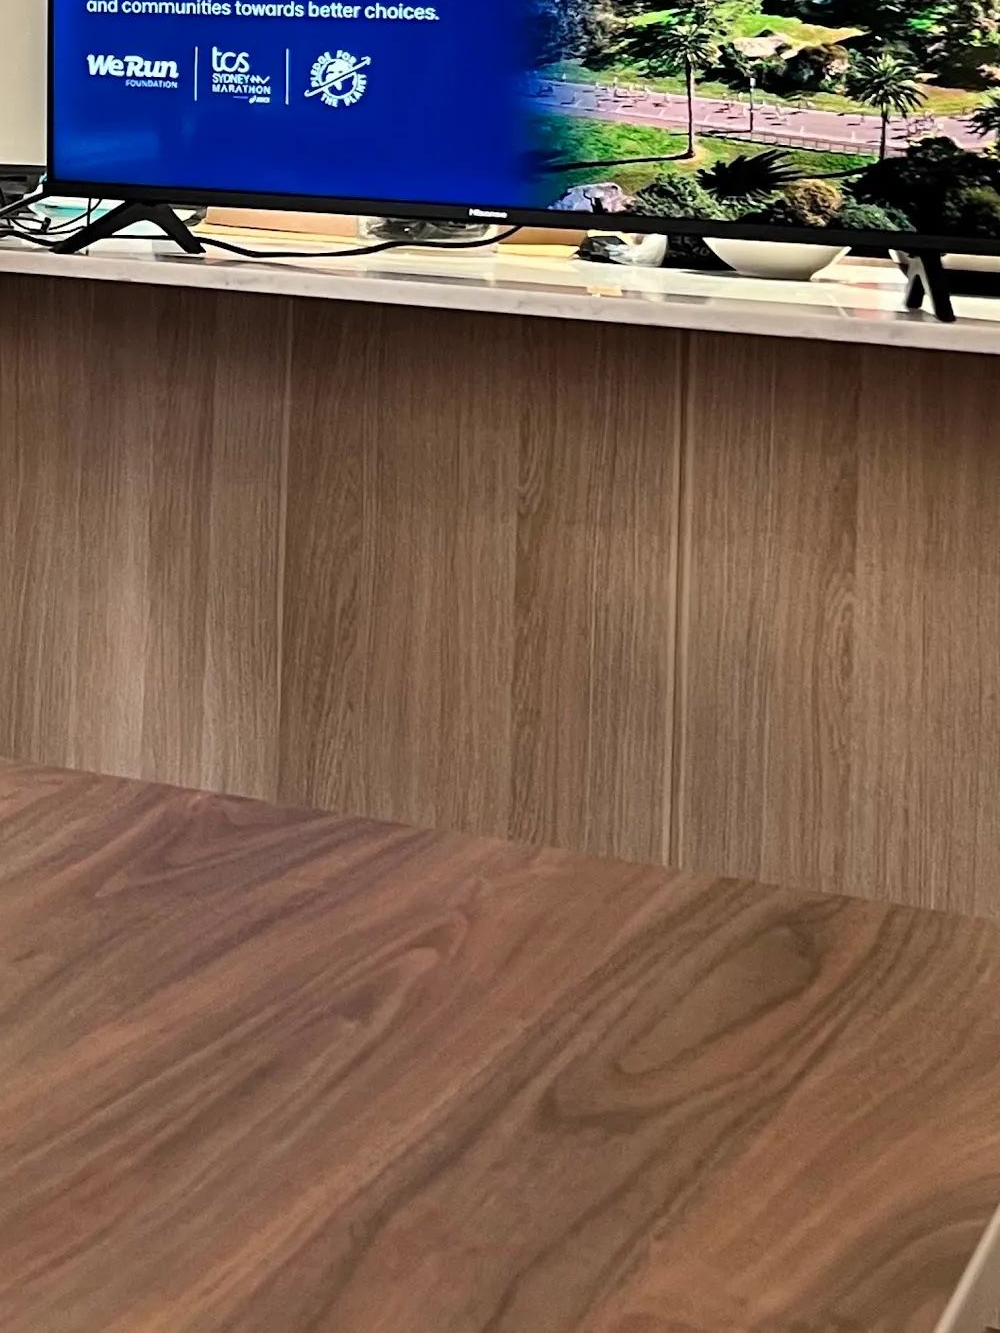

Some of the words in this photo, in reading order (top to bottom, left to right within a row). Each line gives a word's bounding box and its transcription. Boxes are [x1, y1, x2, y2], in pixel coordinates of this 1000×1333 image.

[121, 0, 232, 16] communities
[235, 0, 305, 18] towards
[308, 1, 361, 19] better
[364, 3, 440, 21] choices.
[125, 79, 178, 89] FOUNDATION
[212, 73, 250, 84] SYDNEY
[212, 84, 271, 95] MARATHON
